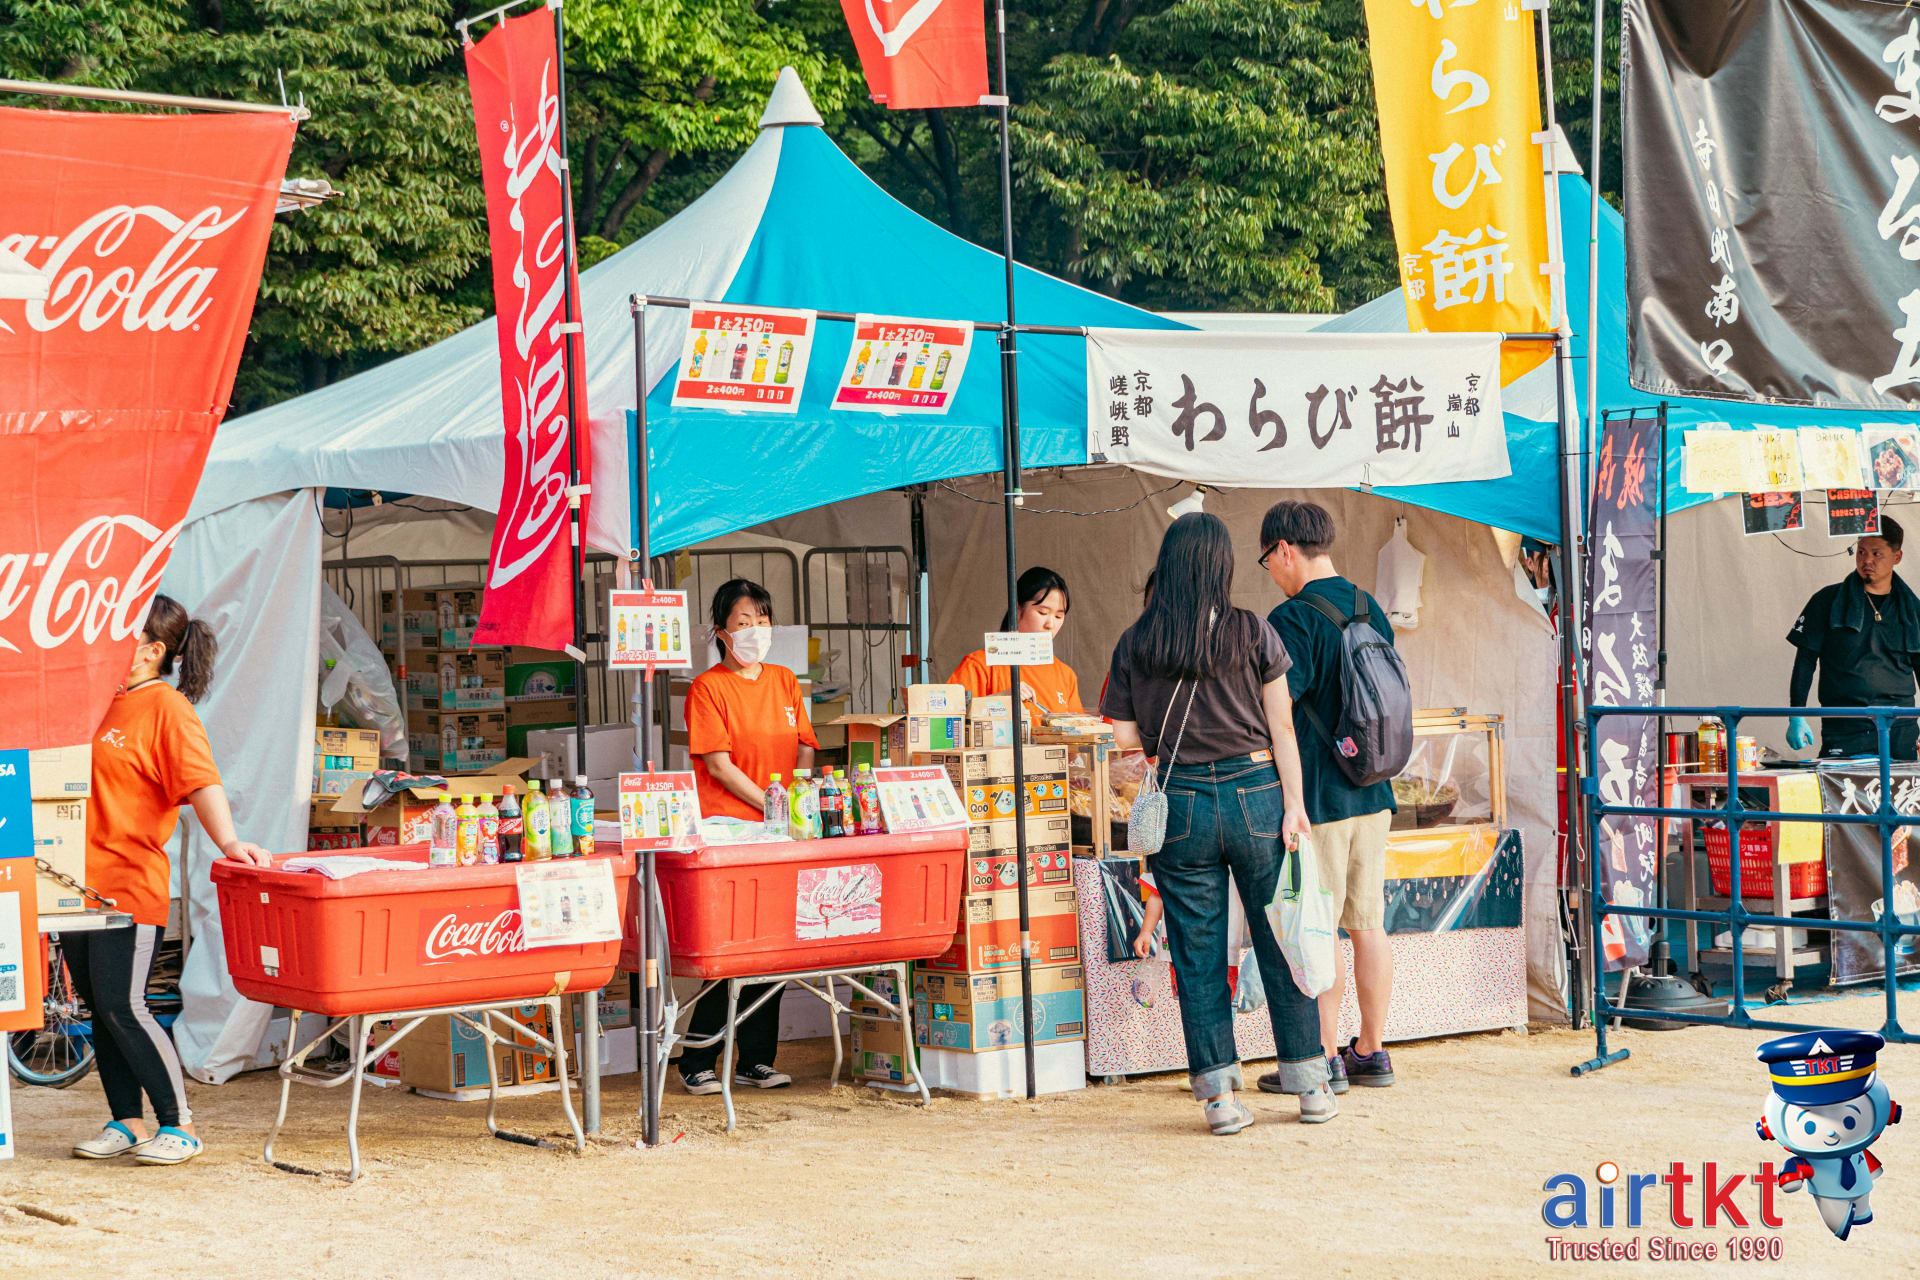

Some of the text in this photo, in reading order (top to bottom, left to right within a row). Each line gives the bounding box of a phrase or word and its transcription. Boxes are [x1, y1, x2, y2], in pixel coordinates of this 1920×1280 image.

[1410, 0, 1514, 311] らび餅
[714, 316, 774, 333] 1本250円
[879, 327, 935, 343] 1本250円
[706, 385, 745, 396] 2本400円
[1109, 375, 1129, 447] 嵯峨野
[1133, 369, 1153, 418] 京都
[1464, 372, 1481, 416] 京都
[1171, 373, 1434, 453] わらび餅
[1447, 393, 1463, 438] 嵐山
[970, 802, 989, 813] Qoo
[973, 875, 993, 885] Qoo
